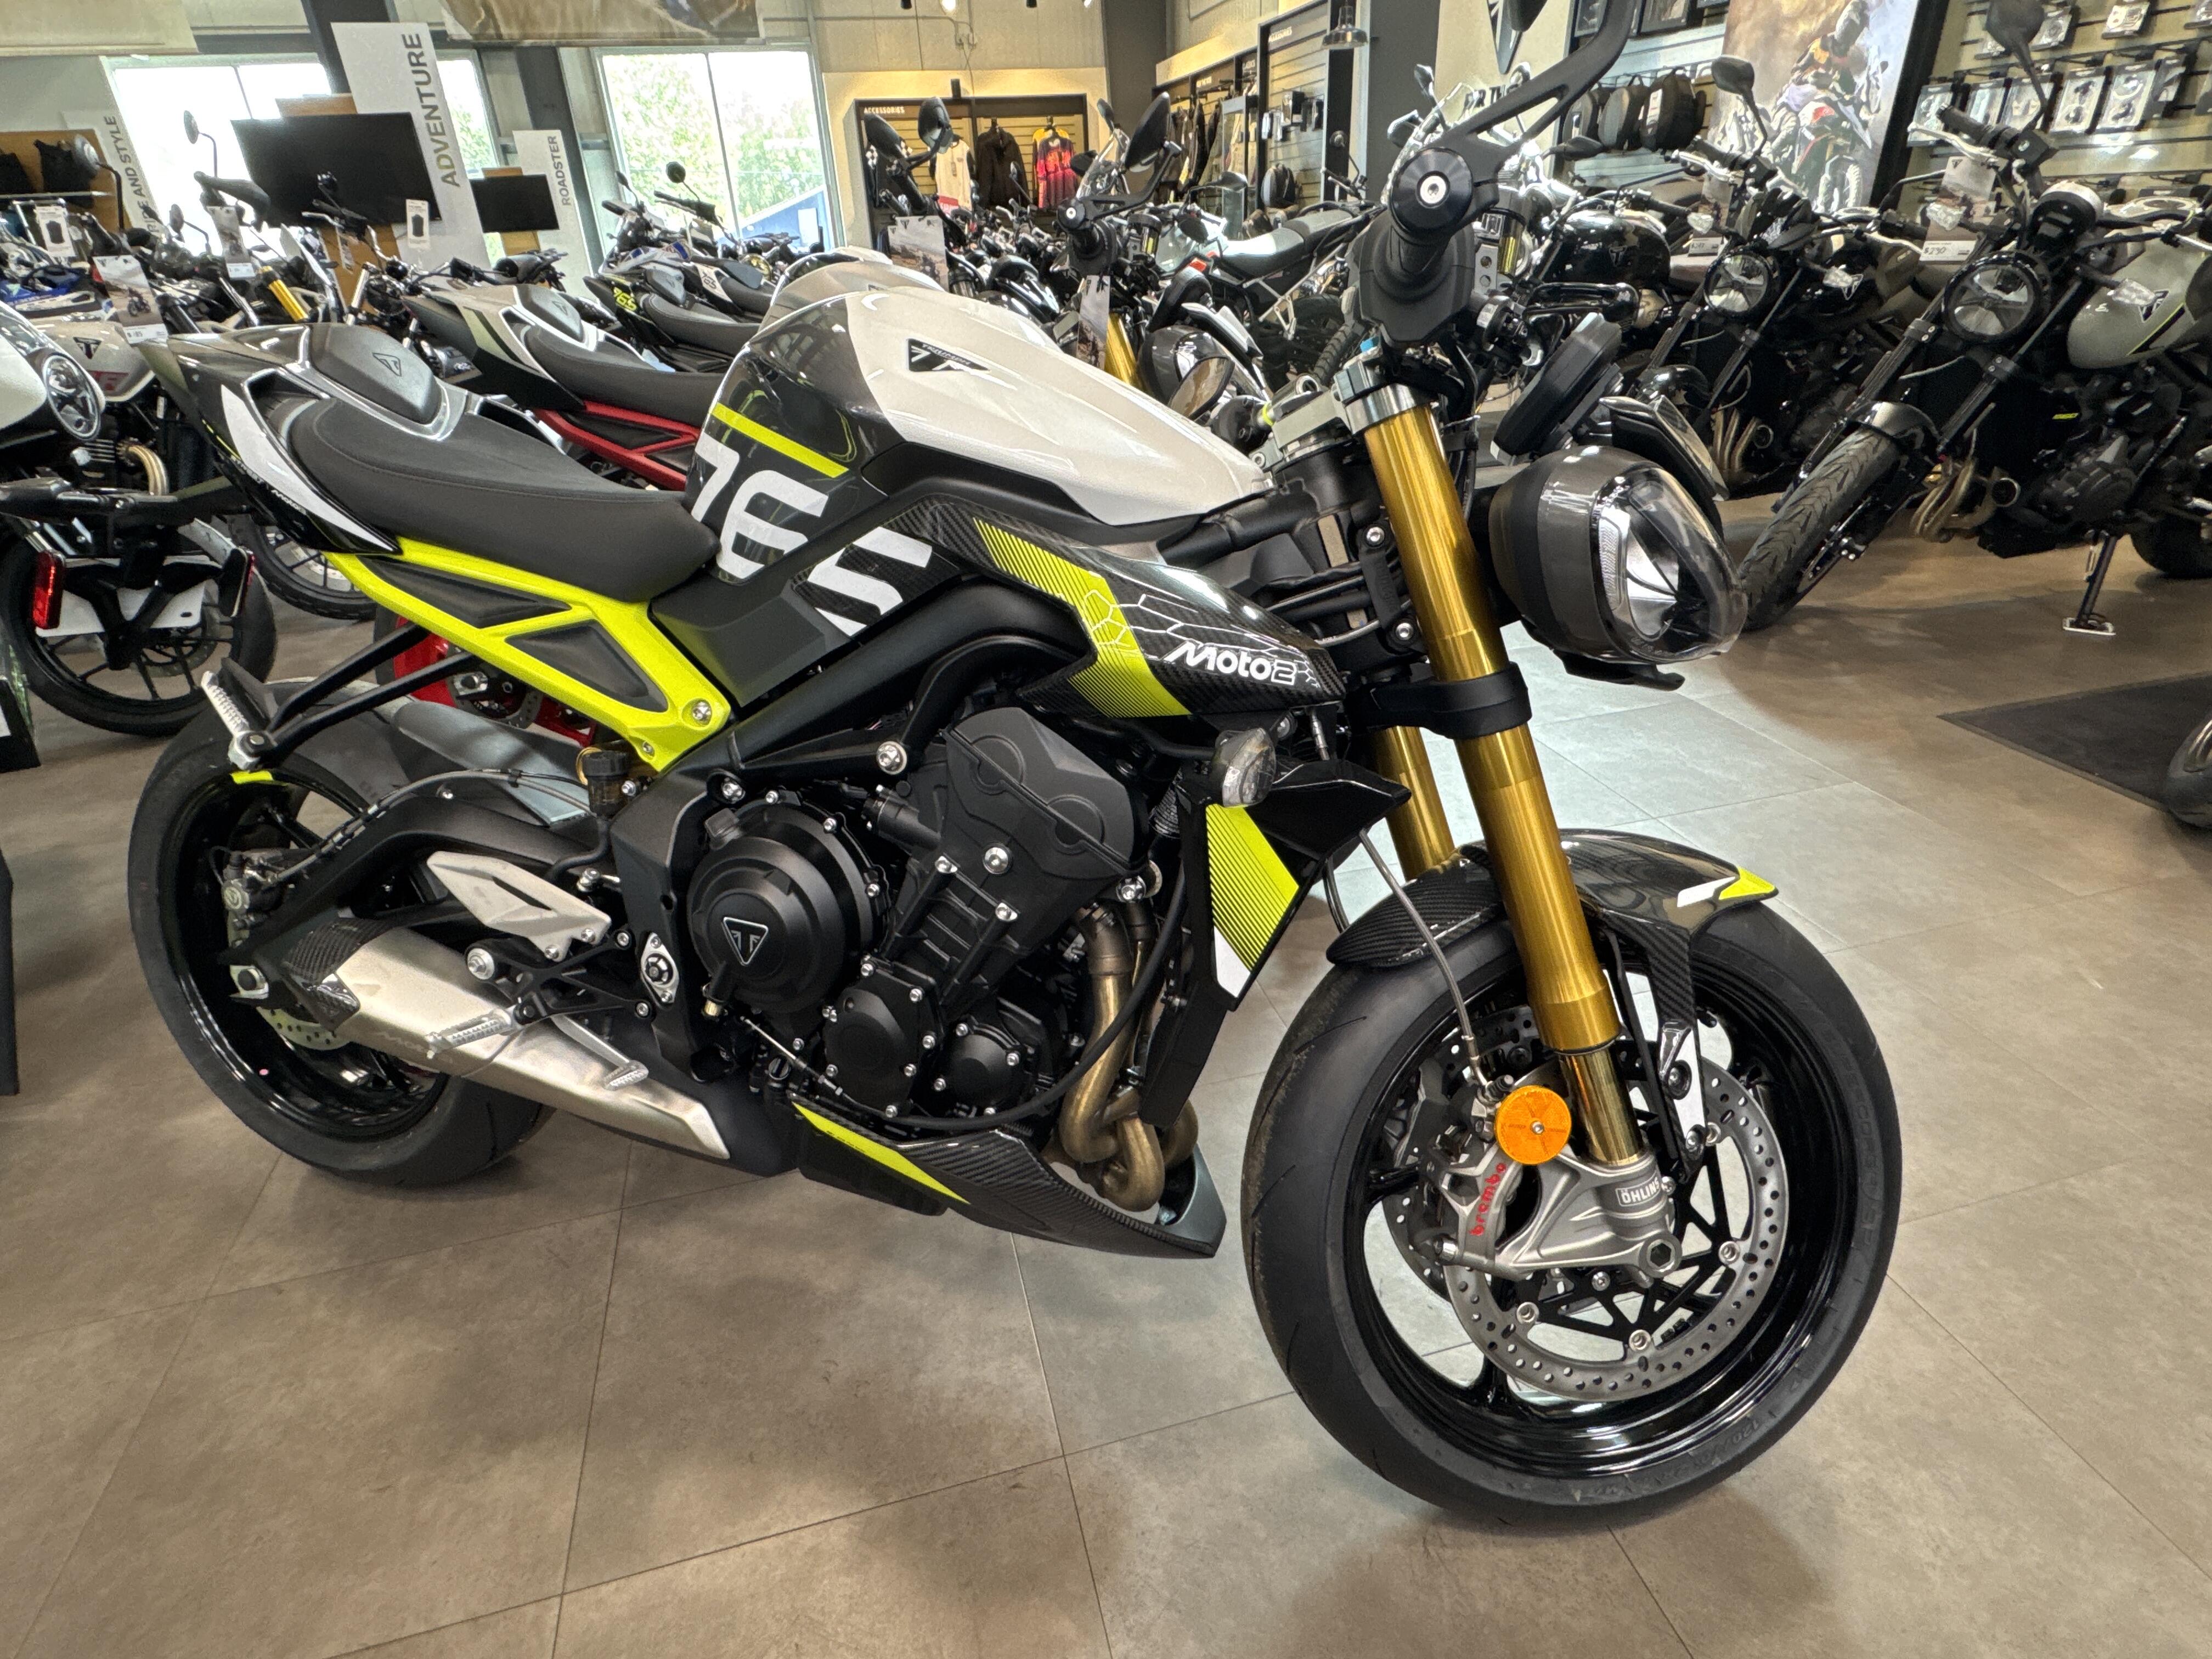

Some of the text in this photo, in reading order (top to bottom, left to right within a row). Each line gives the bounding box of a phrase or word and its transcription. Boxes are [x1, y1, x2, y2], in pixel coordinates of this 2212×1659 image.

[402, 33, 460, 187] ADVENTURE
[104, 116, 132, 164] STYLE
[125, 167, 146, 198] AND
[548, 136, 572, 206] ROADSTER
[613, 286, 637, 311] 765
[701, 271, 718, 290] 765
[1161, 639, 1296, 686] Moto2
[1469, 1163, 1506, 1237] brembo
[1621, 1177, 1660, 1204] ÖHLINS
